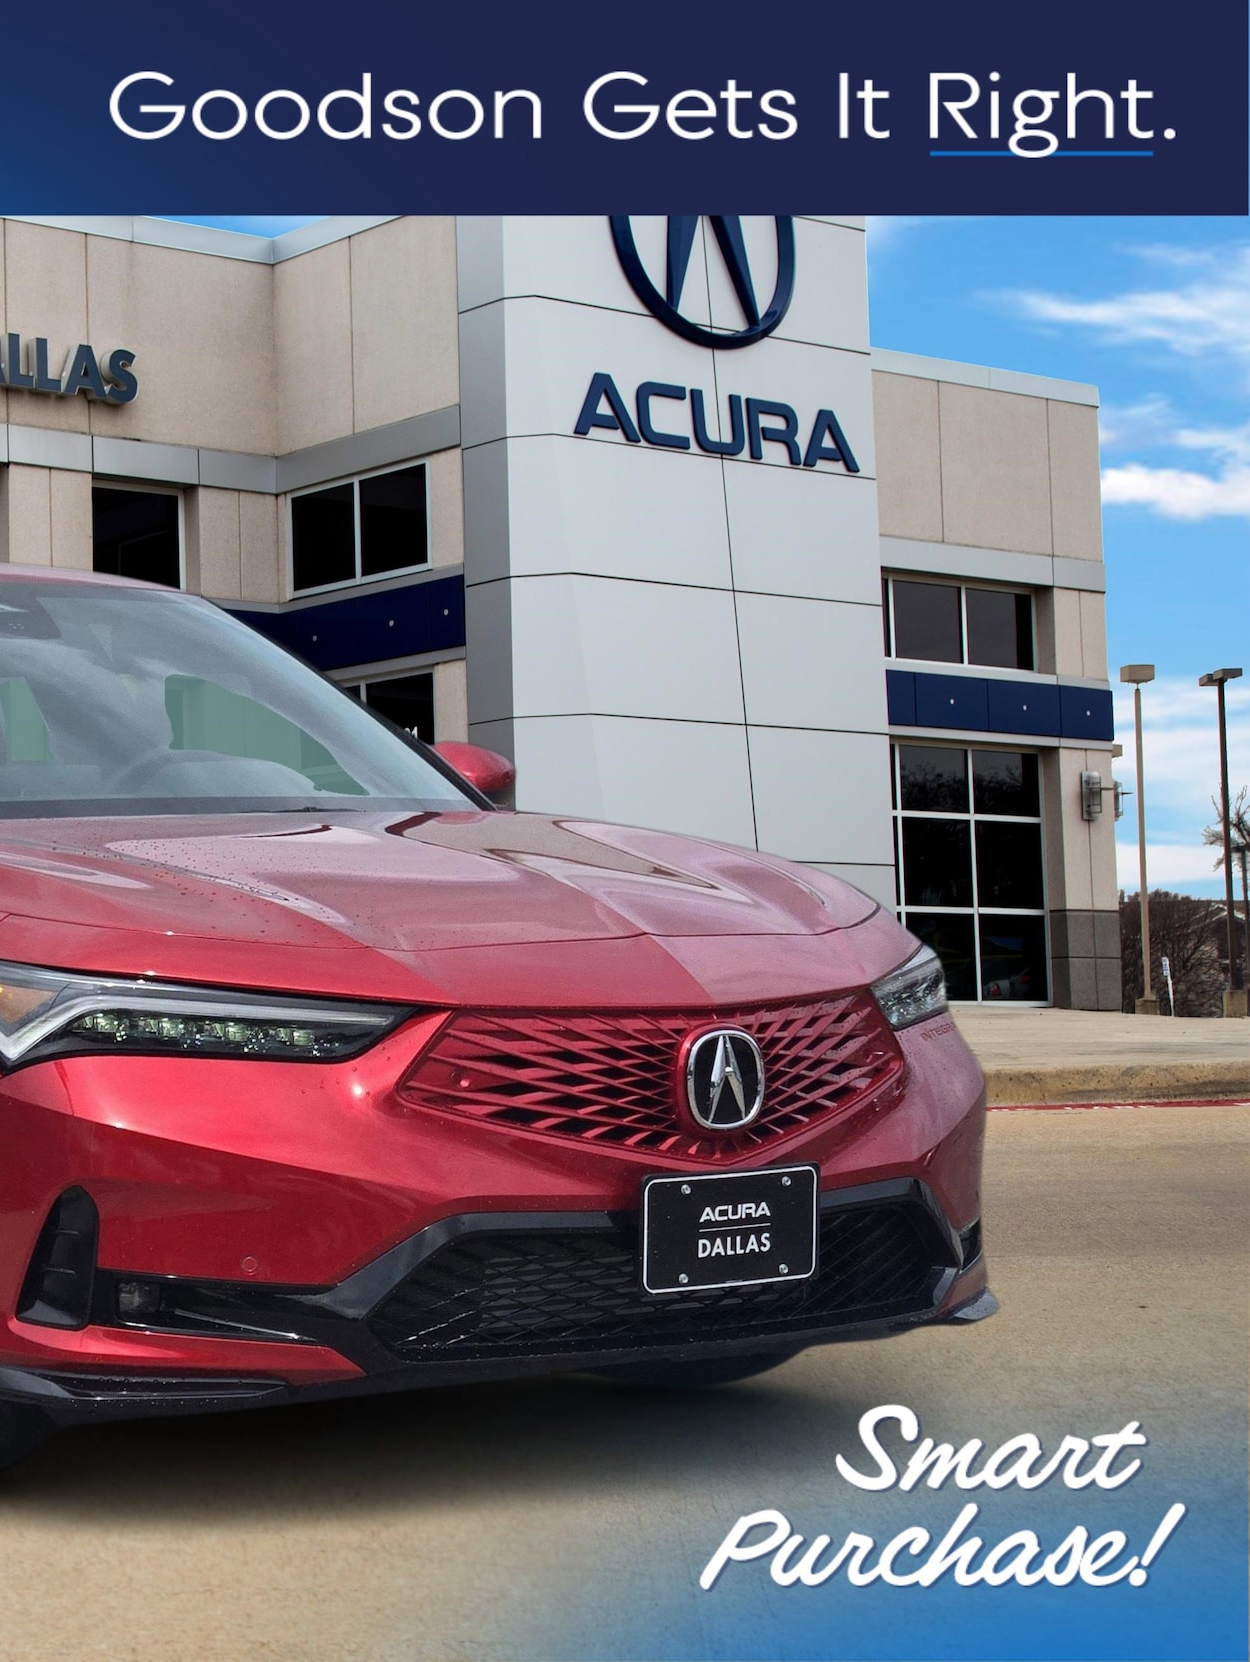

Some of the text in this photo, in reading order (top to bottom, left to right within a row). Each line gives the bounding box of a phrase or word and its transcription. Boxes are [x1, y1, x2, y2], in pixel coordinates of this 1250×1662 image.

[573, 372, 862, 474] ACURA
[699, 1202, 771, 1222] ACURA
[698, 1233, 771, 1259] DALLAS
